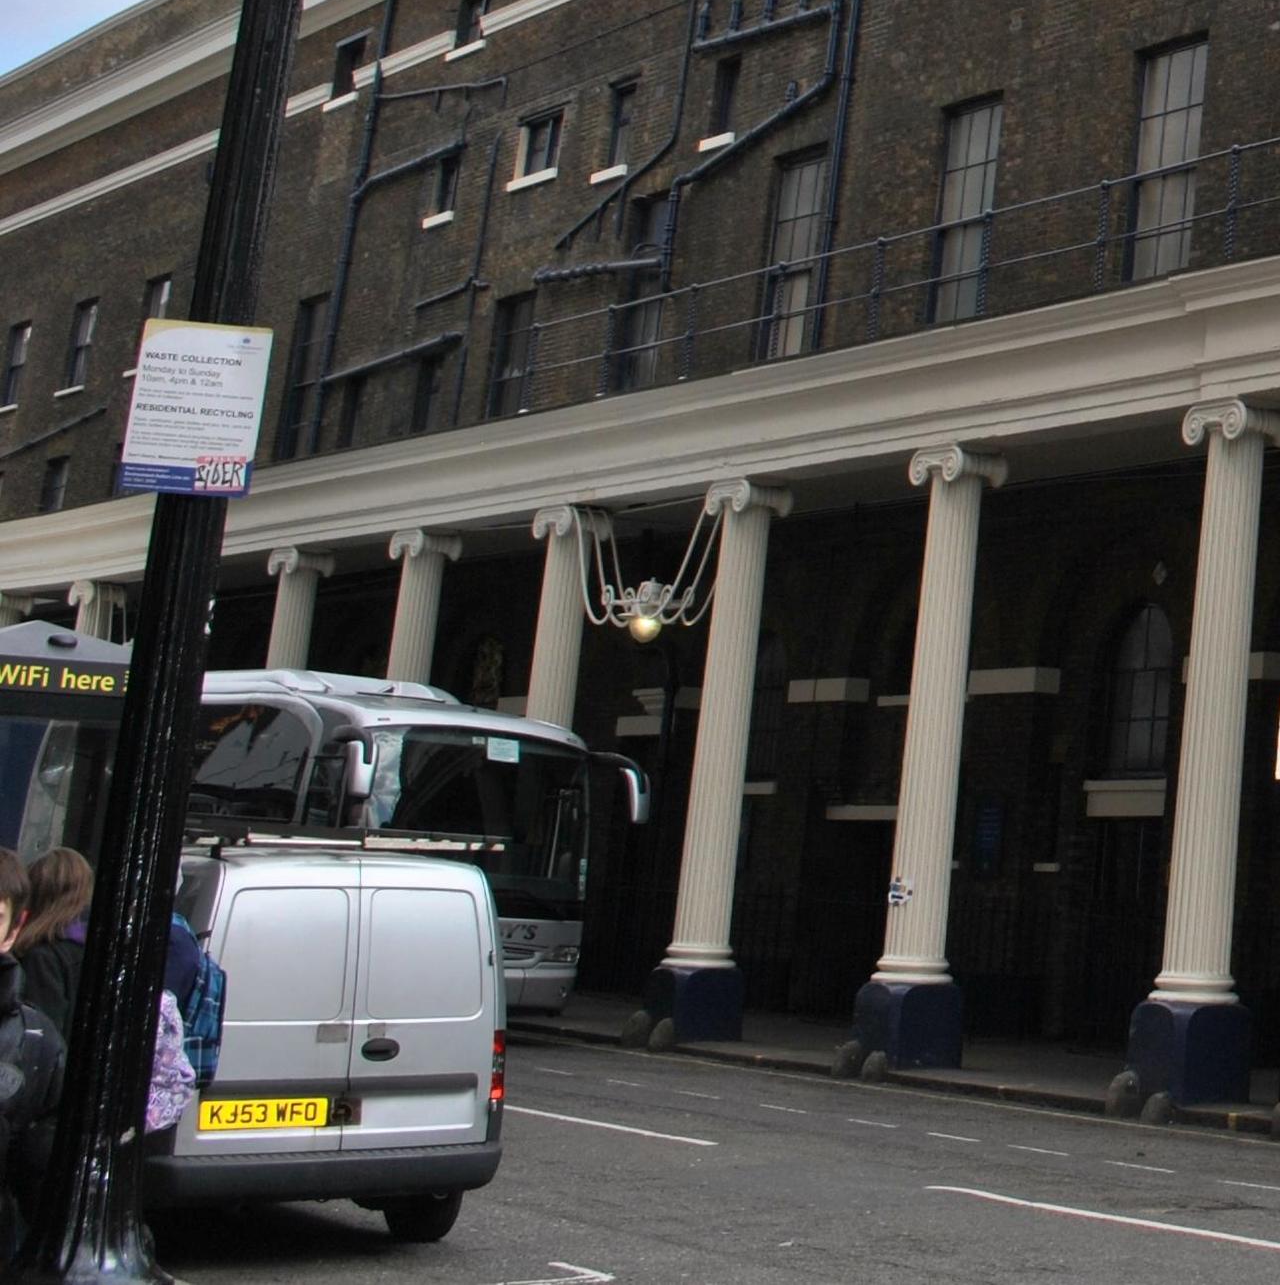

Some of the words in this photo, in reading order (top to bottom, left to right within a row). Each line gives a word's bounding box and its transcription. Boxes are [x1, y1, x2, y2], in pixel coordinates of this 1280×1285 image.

[145, 351, 178, 362] WASTE
[181, 354, 242, 367] COLLECTION
[142, 365, 176, 375] Monday
[188, 368, 221, 378] Sunday
[135, 402, 197, 415] RESIDENTIAL
[200, 407, 254, 419] RECYCLING
[0, 663, 50, 688] WiFi
[61, 667, 115, 691] here
[209, 1103, 268, 1124] KJ53
[276, 1102, 318, 1122] WFO
